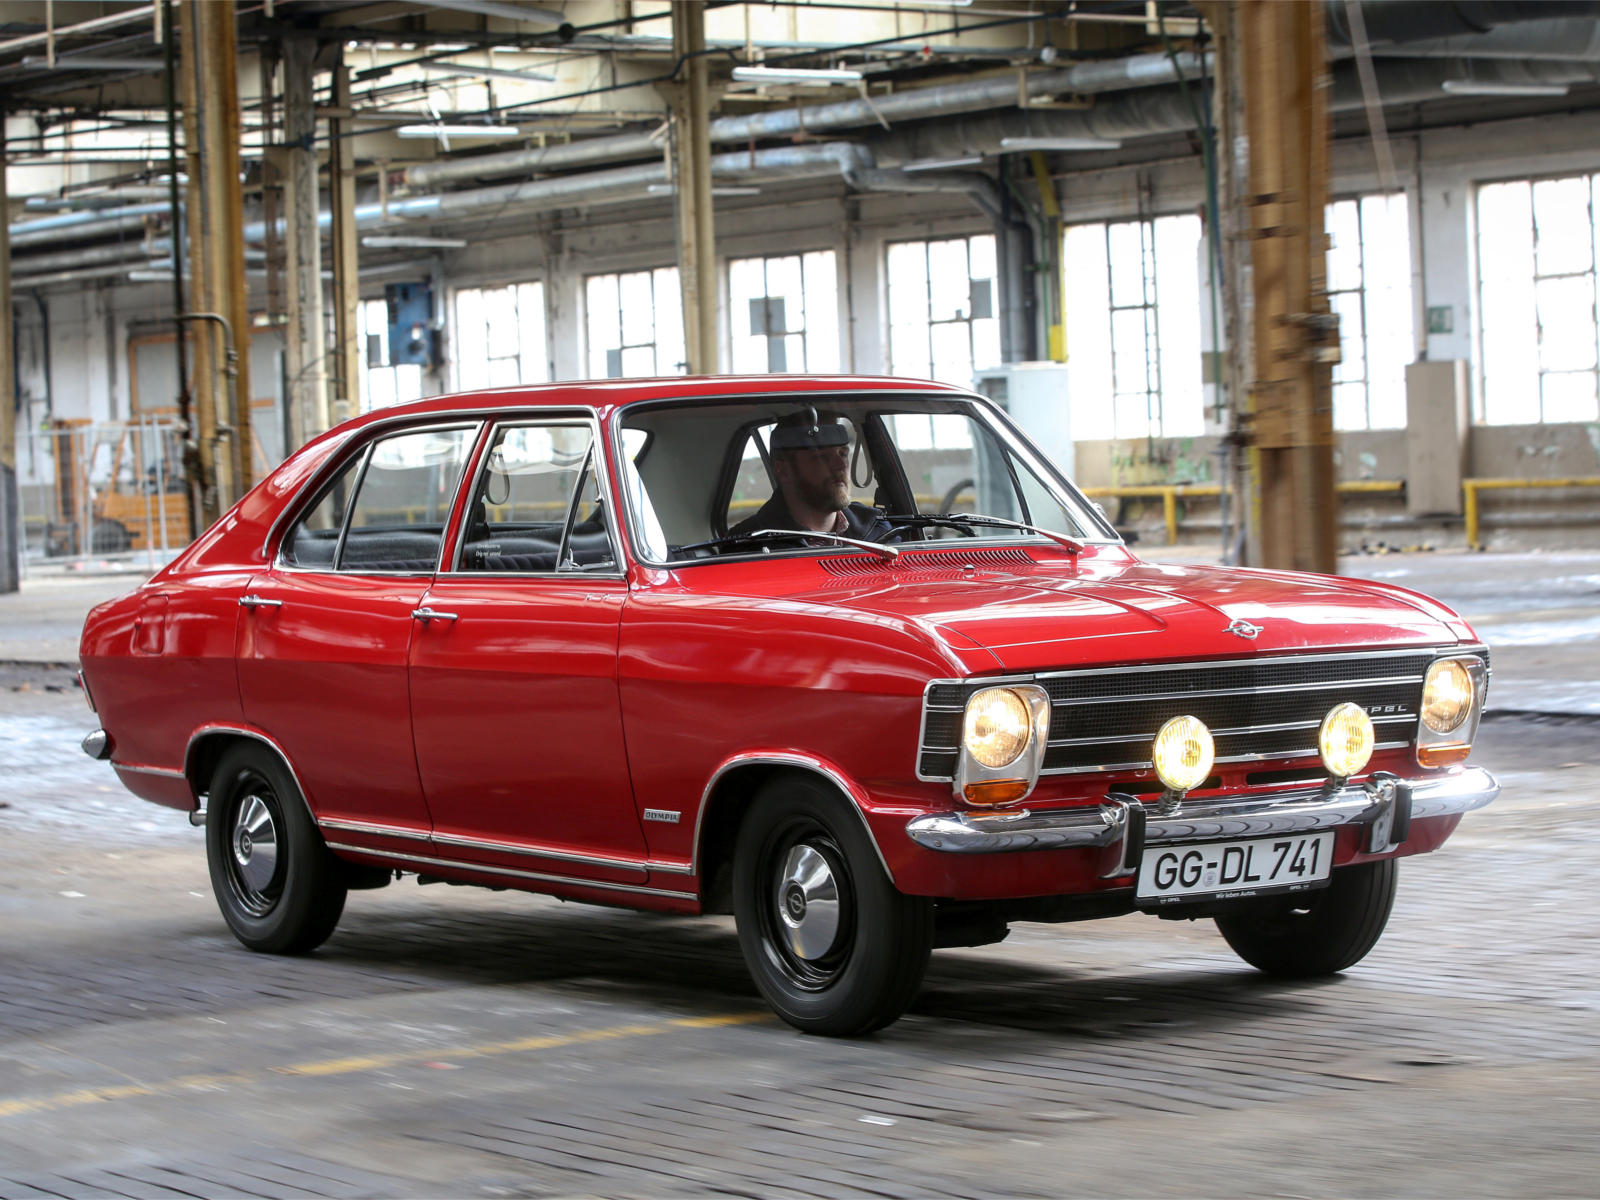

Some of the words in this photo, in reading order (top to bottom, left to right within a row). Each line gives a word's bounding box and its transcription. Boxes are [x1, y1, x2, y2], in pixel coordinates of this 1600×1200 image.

[645, 811, 678, 820] OLYMPIA
[1154, 845, 1261, 890] GG-DL
[1268, 838, 1321, 880] 741
